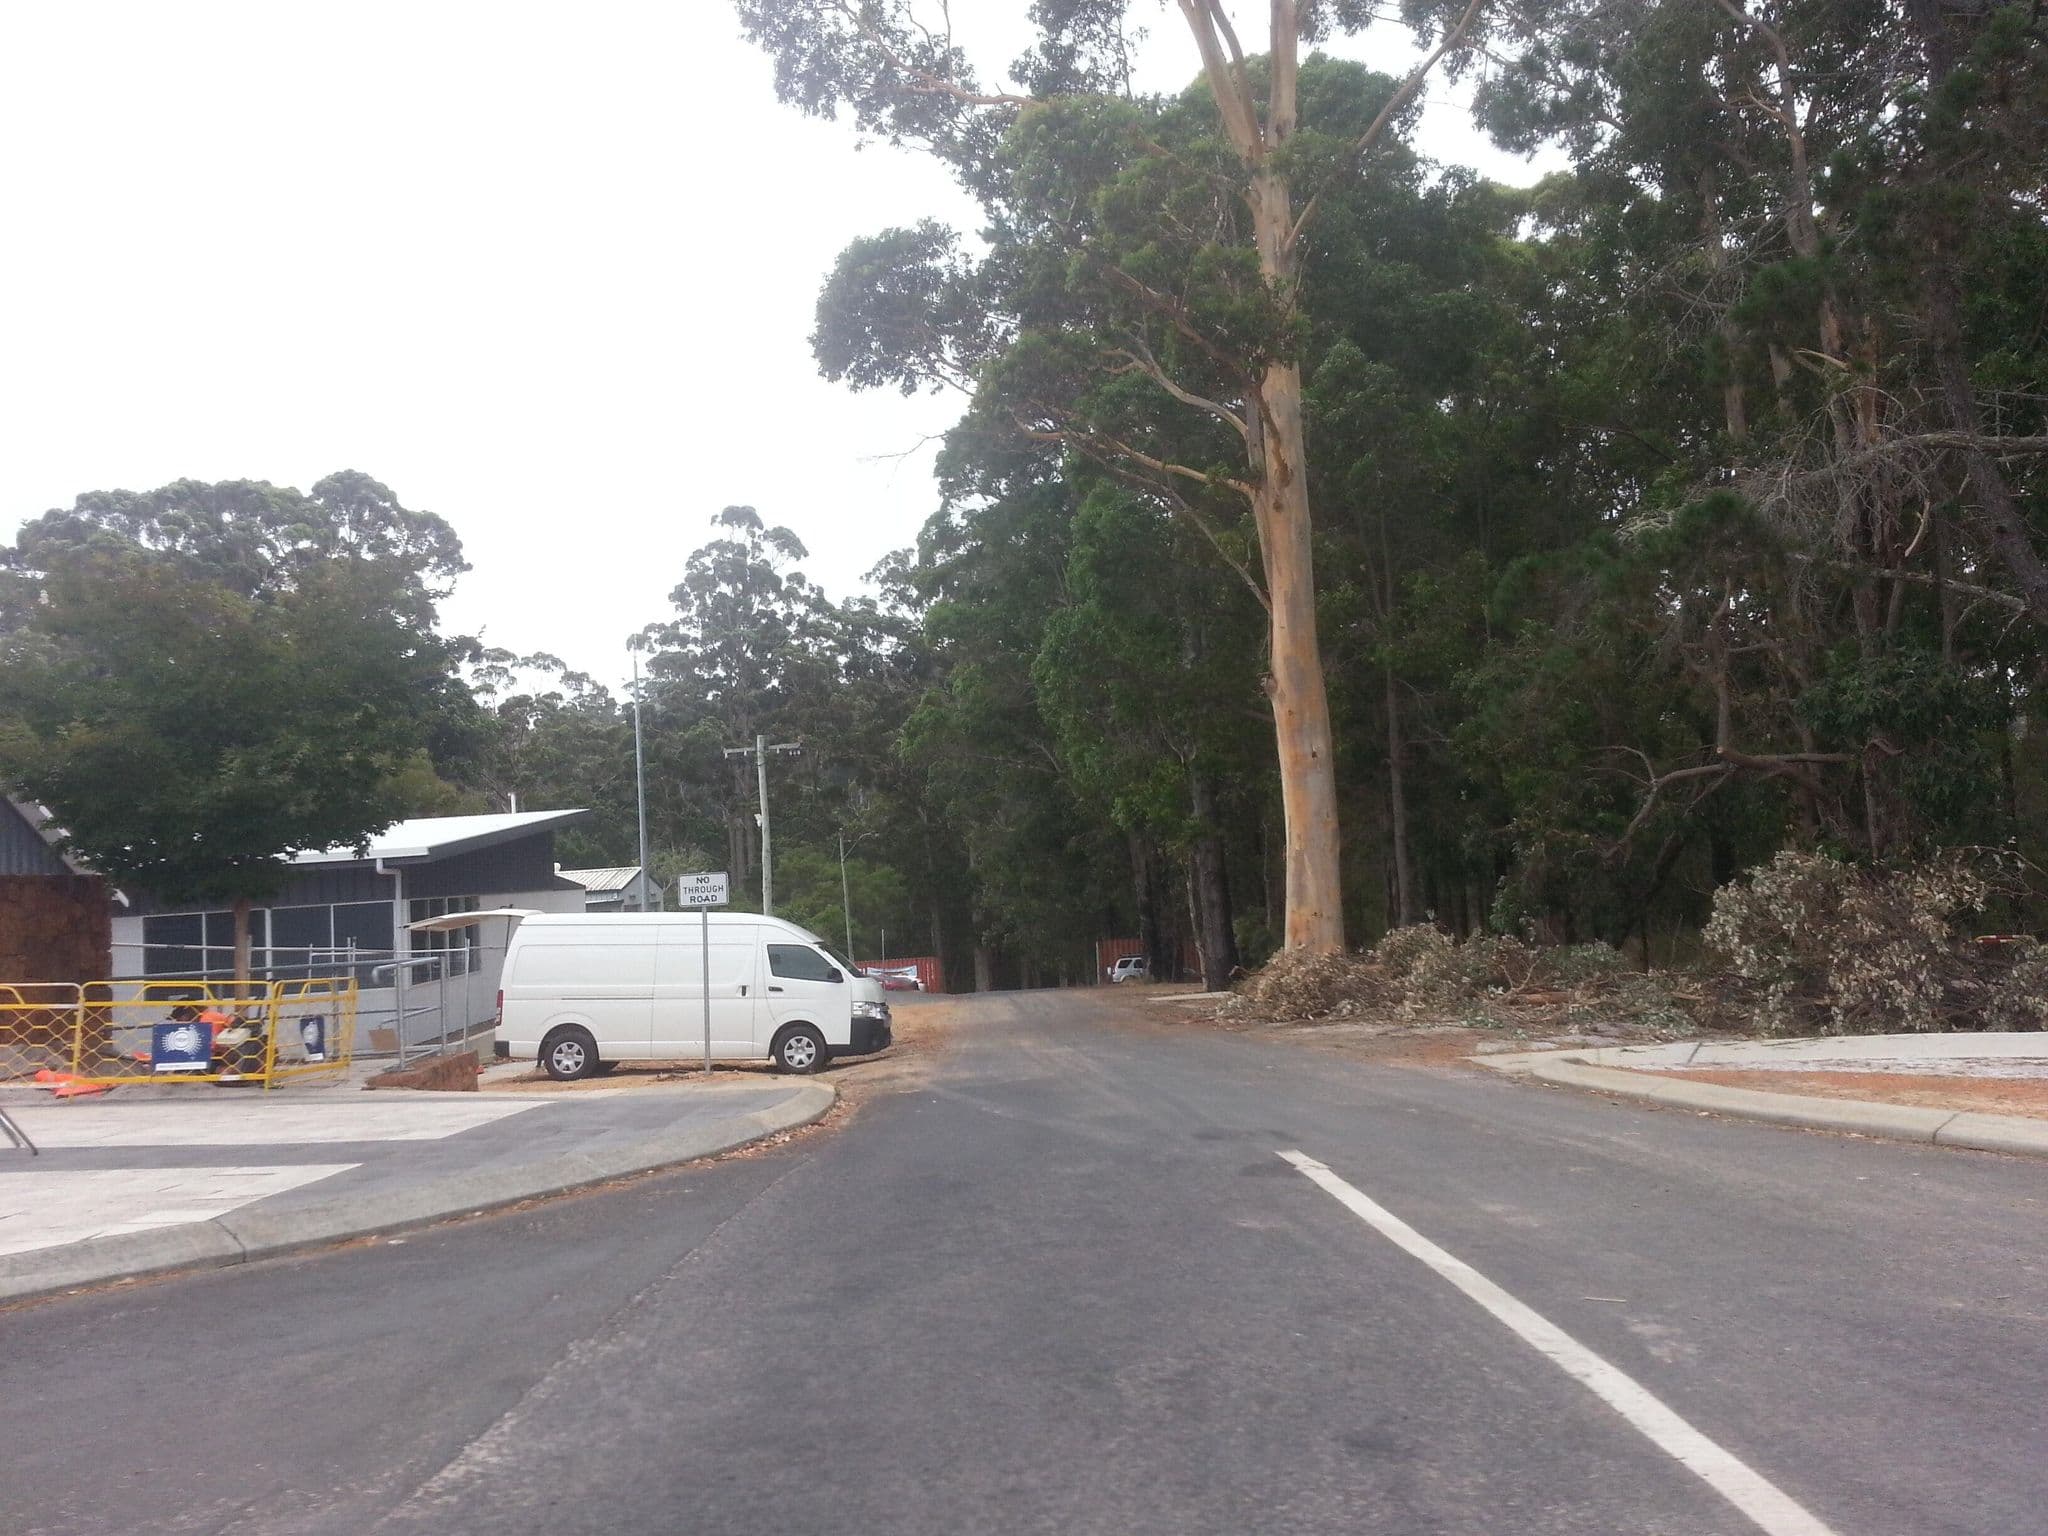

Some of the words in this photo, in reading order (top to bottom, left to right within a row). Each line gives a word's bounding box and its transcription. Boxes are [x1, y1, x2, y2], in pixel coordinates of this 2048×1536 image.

[696, 876, 710, 884] NO
[683, 885, 724, 895] THROUGH
[689, 895, 718, 903] ROAD
